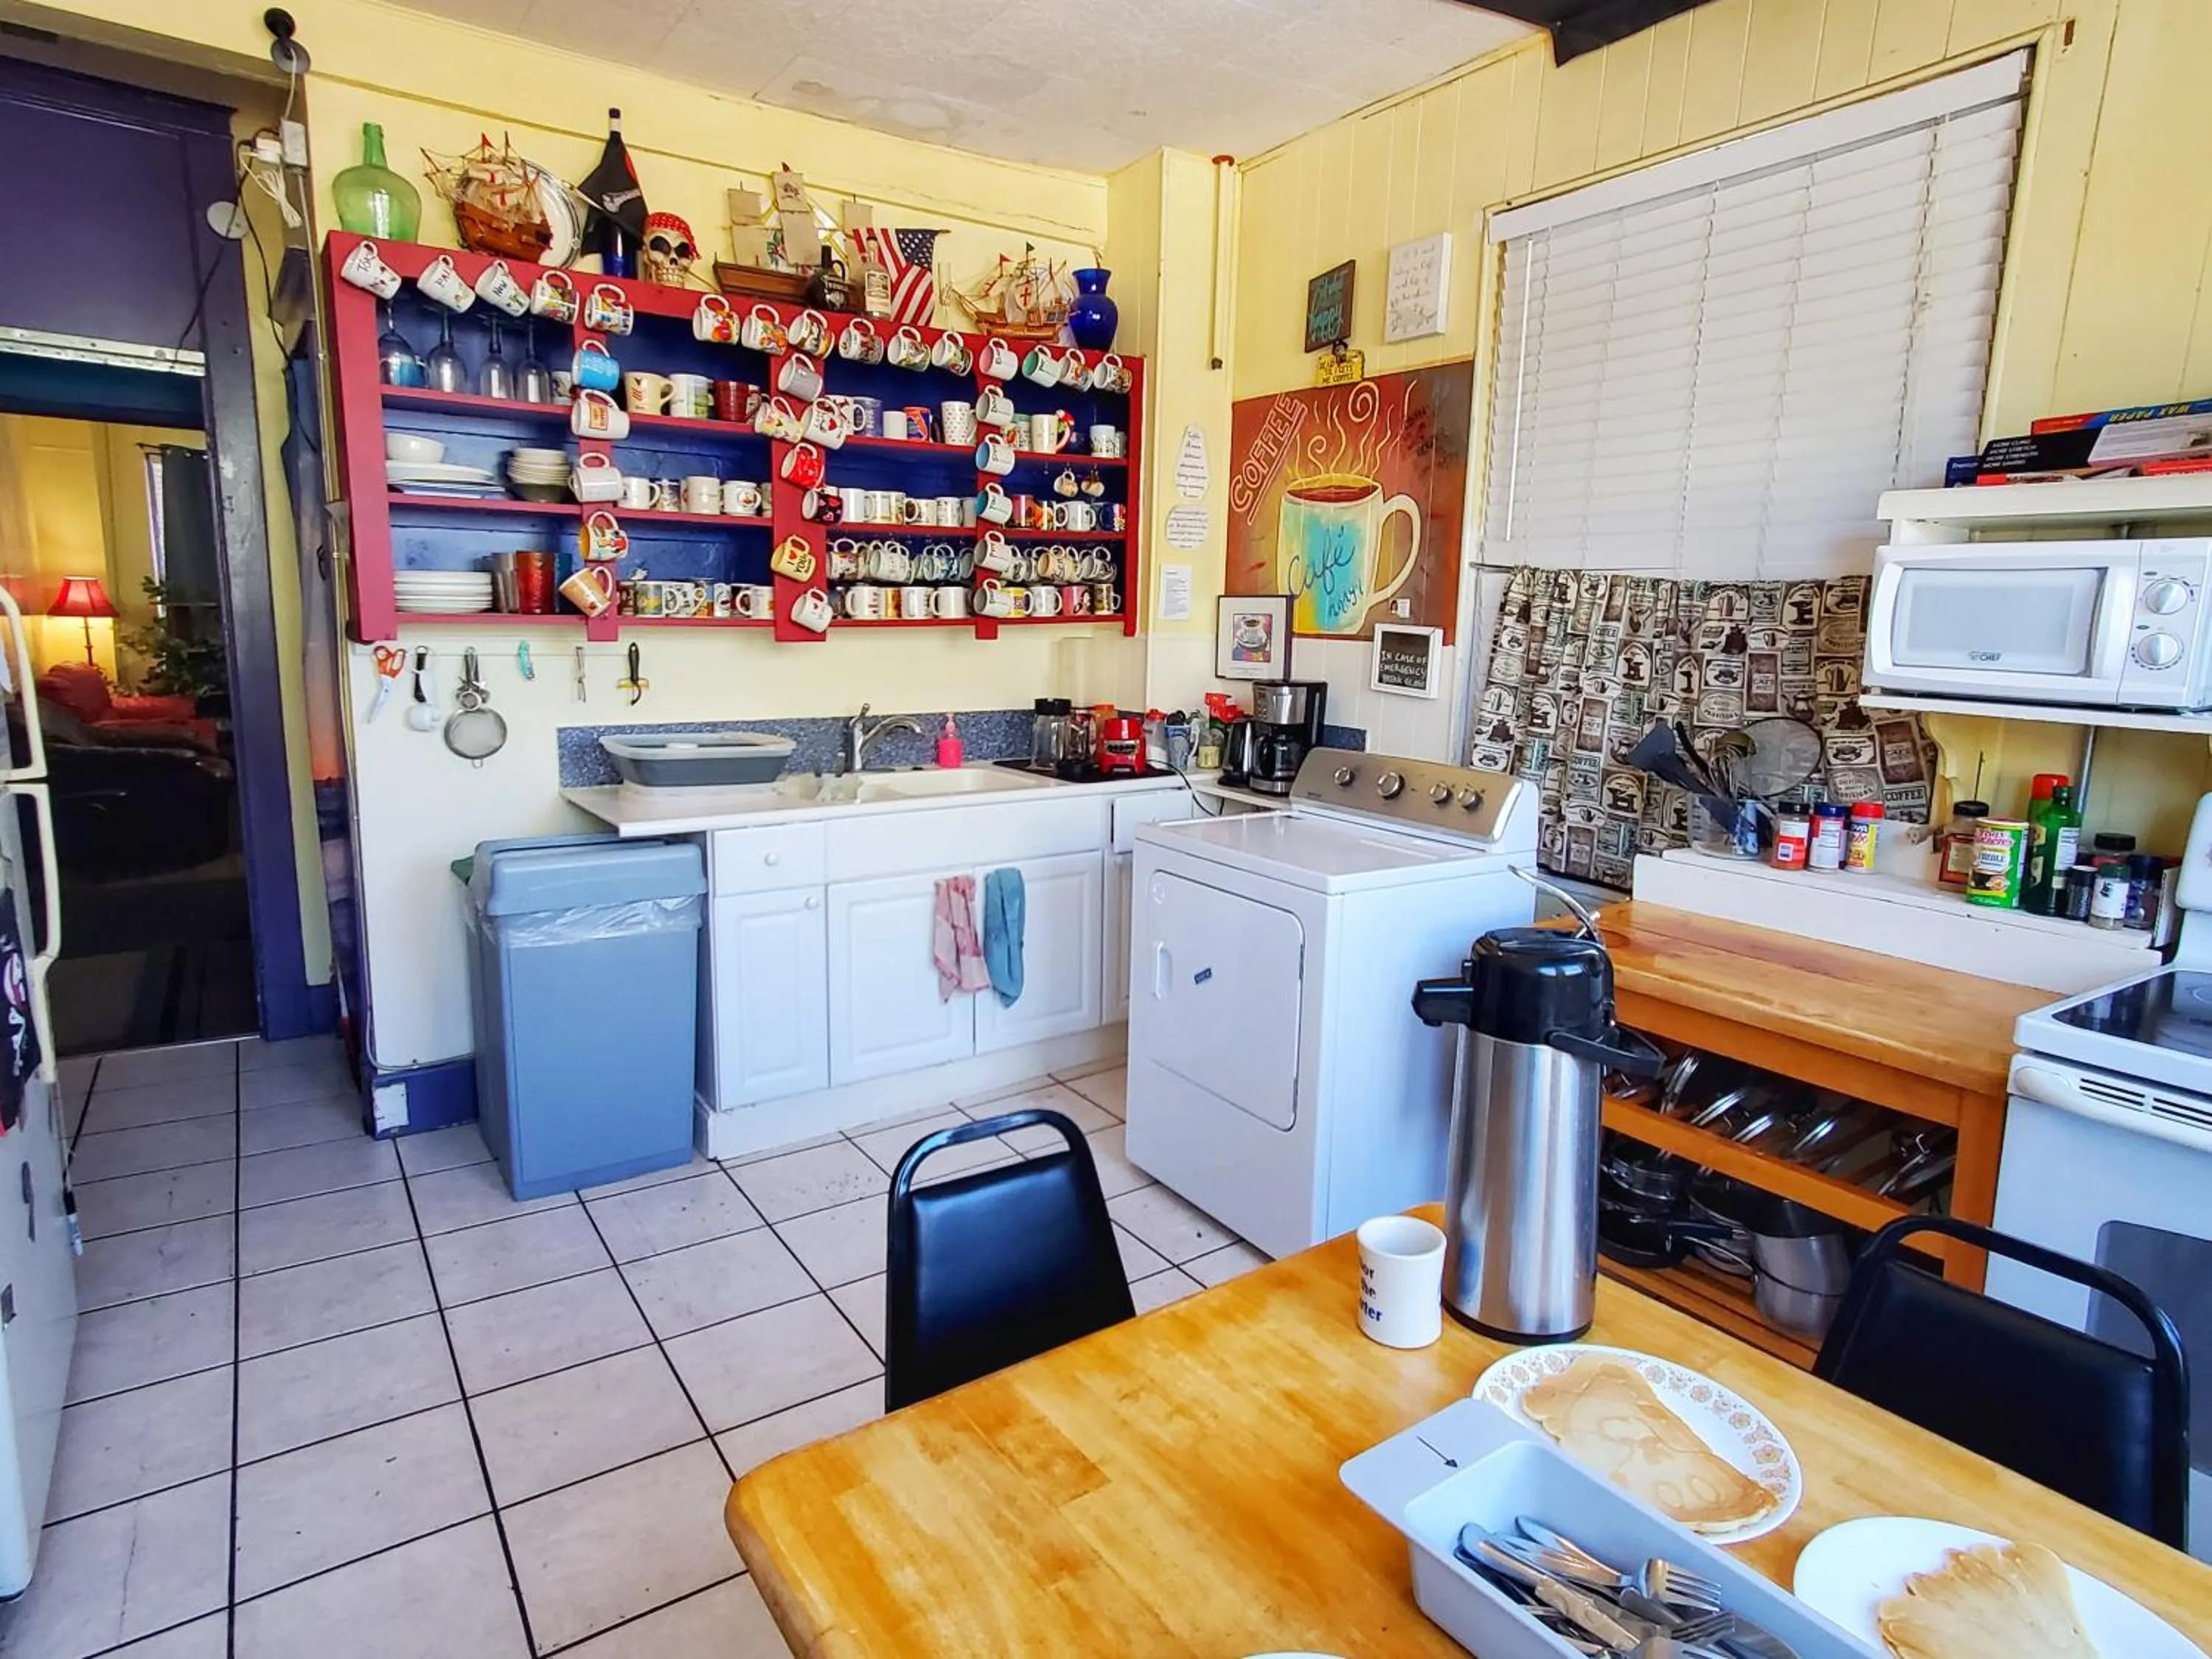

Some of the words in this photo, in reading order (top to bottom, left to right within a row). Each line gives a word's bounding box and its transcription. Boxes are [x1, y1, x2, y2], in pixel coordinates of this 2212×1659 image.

[1231, 392, 1305, 512] COFFEE
[1289, 526, 1355, 599] Café
[1885, 789, 1924, 801] COFFEE
